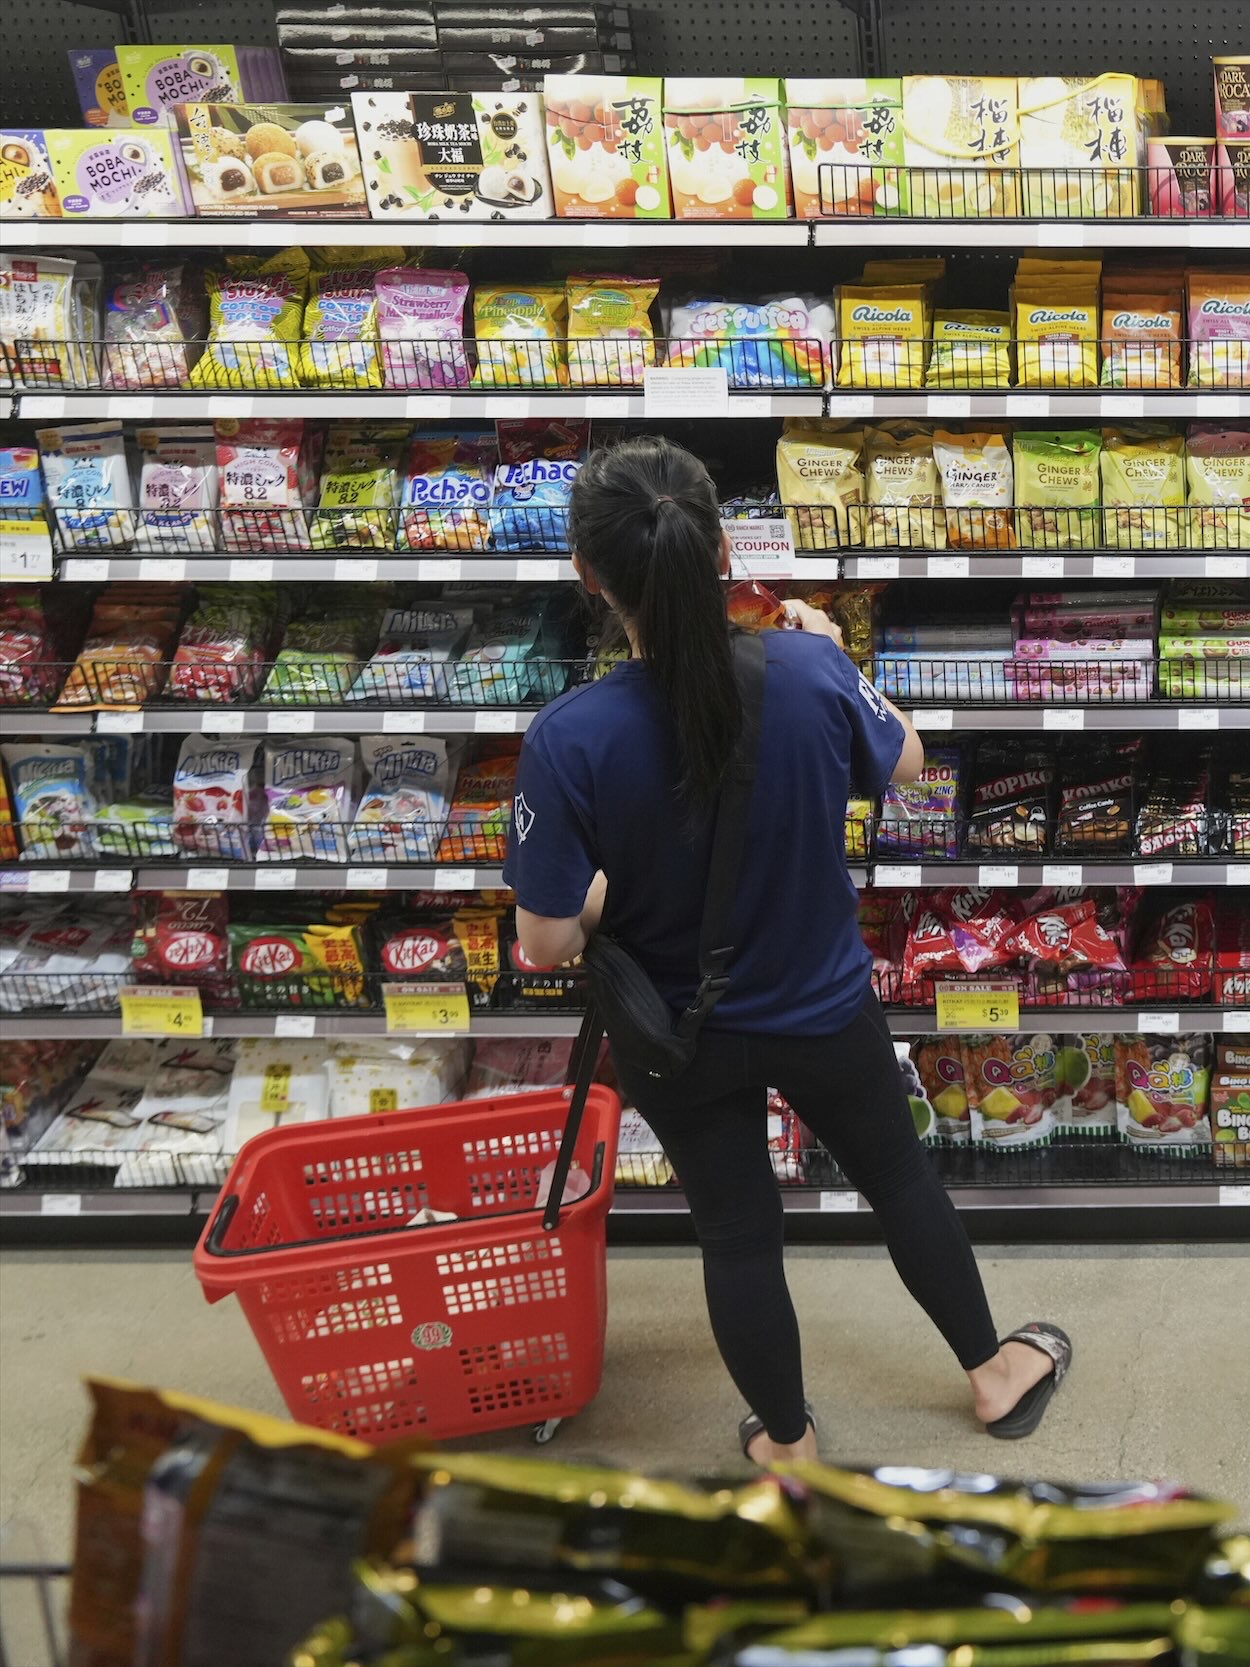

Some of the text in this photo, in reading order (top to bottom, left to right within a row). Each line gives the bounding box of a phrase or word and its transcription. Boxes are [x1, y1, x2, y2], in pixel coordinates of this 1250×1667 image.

[155, 69, 193, 91] BOBA
[1219, 71, 1245, 84] DARK
[1218, 83, 1250, 98] ROCA
[416, 122, 470, 142] 珍珠奶茶
[438, 148, 464, 163] 大福
[1179, 151, 1207, 164] DARK
[86, 157, 124, 178] BOBA
[220, 302, 282, 314] COTTON
[392, 296, 452, 309] Strawberry
[484, 305, 543, 318] Pineapple
[852, 306, 913, 322] Ricola
[1029, 310, 1088, 325] Ricola
[690, 305, 811, 333] Jet-Puffed
[1113, 314, 1172, 329] Ricola
[943, 321, 1002, 334] Ricola
[796, 457, 844, 468] GINGER
[874, 454, 916, 467] GINGER
[1123, 458, 1166, 467] GINGER
[1203, 458, 1245, 467] GINGER
[799, 467, 841, 477] CHEWS
[875, 465, 914, 477] CHEWS
[1037, 463, 1081, 475] GINGER
[1125, 466, 1165, 478] CHEWS
[1204, 466, 1244, 477] CHEWS
[226, 471, 286, 487] 特濃ミルク
[946, 469, 997, 483] GINGER
[1038, 473, 1079, 486] CHEWS
[326, 480, 377, 493] 特濃ミルク
[244, 487, 268, 501] 8.2
[338, 492, 358, 504] 8.2
[736, 541, 790, 551] COUPON
[978, 769, 1053, 801] KOPIKO
[395, 936, 439, 966] KitKat
